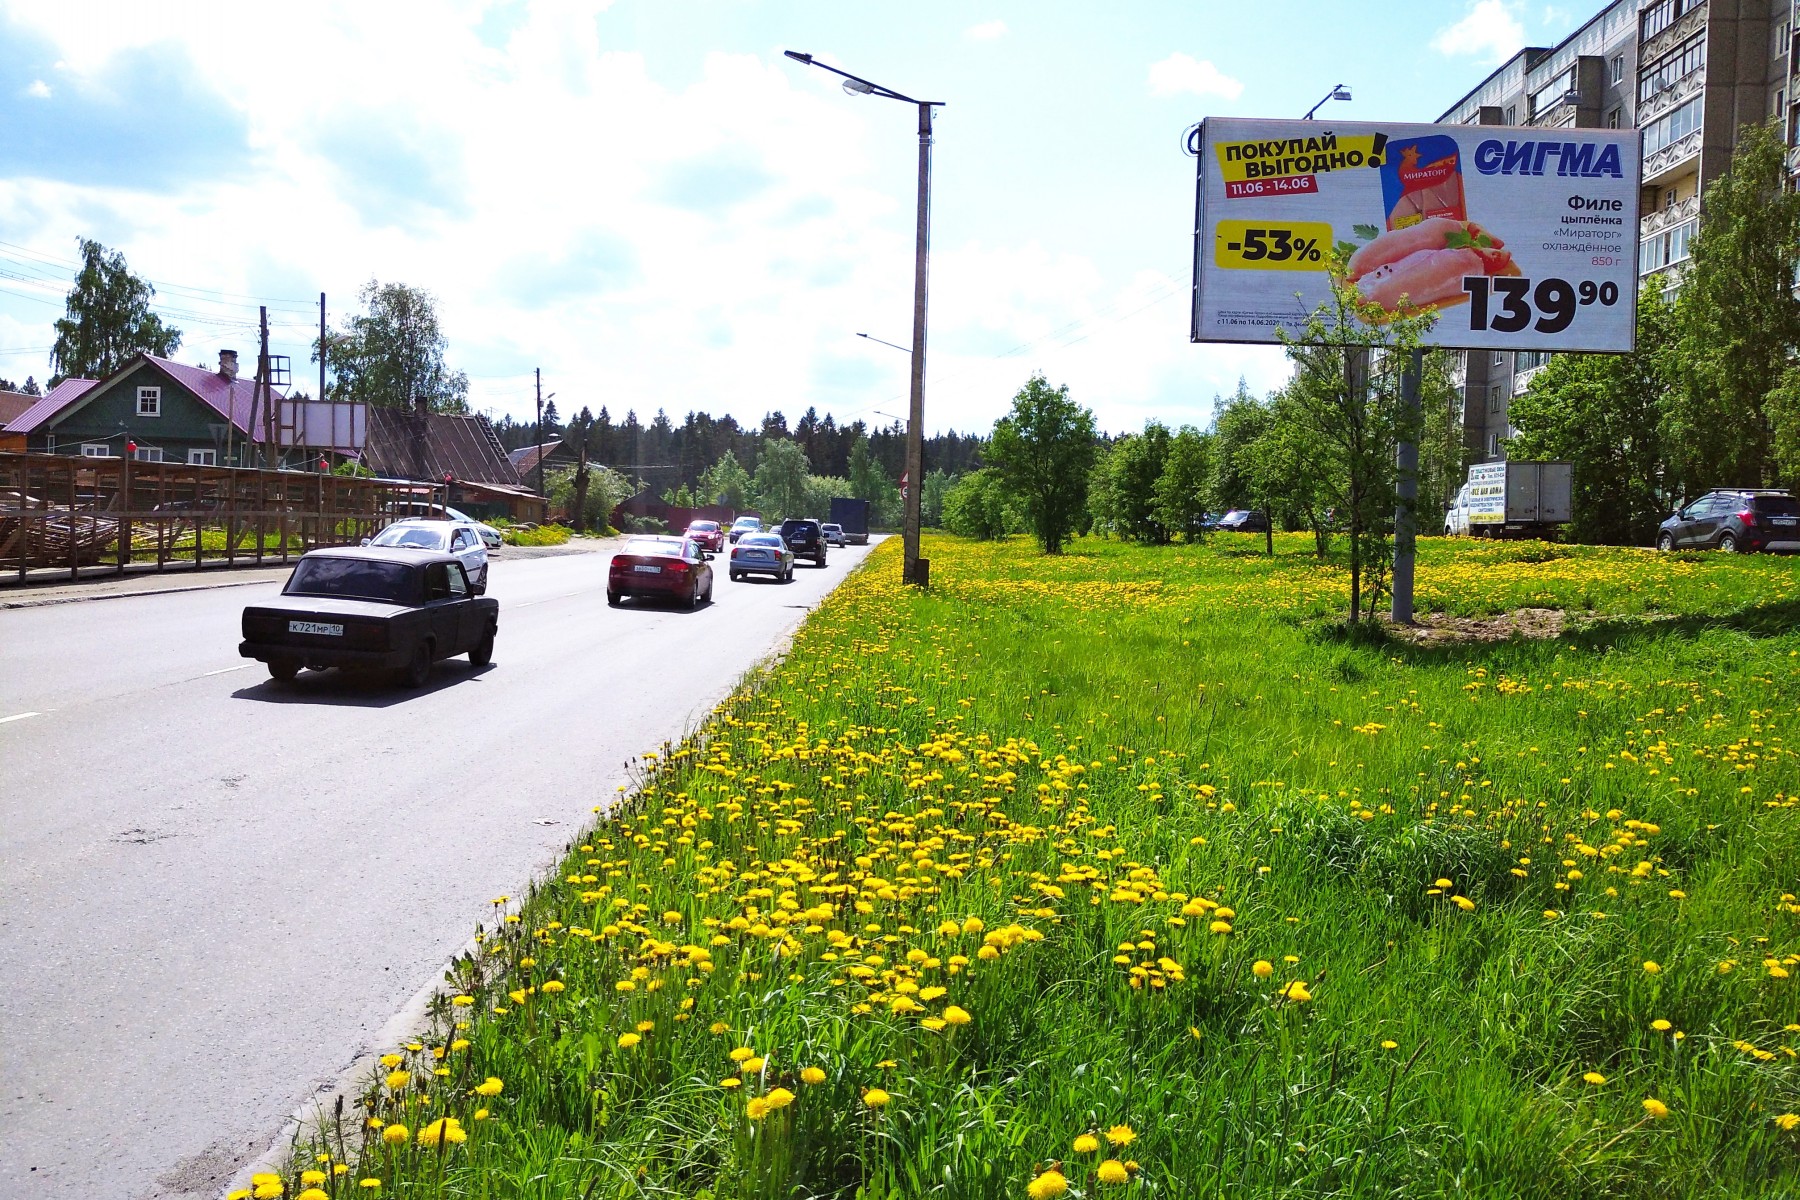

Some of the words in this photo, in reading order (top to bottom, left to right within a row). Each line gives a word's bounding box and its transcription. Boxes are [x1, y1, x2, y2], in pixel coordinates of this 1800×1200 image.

[1226, 131, 1338, 161] ПОКУПАЙ
[1474, 139, 1624, 178] СИГМА
[1404, 168, 1447, 180] МИРАТОРГ
[1231, 182, 1264, 195] 11.06
[1272, 178, 1310, 191] 14.06
[1568, 195, 1623, 211] Филе
[1561, 215, 1622, 225] цыплёнка
[1553, 228, 1622, 240] «Мираторг»
[1227, 229, 1321, 262] -53%
[1542, 242, 1622, 253] охлаждённое
[1591, 257, 1613, 266] 850
[1463, 276, 1577, 334] 139
